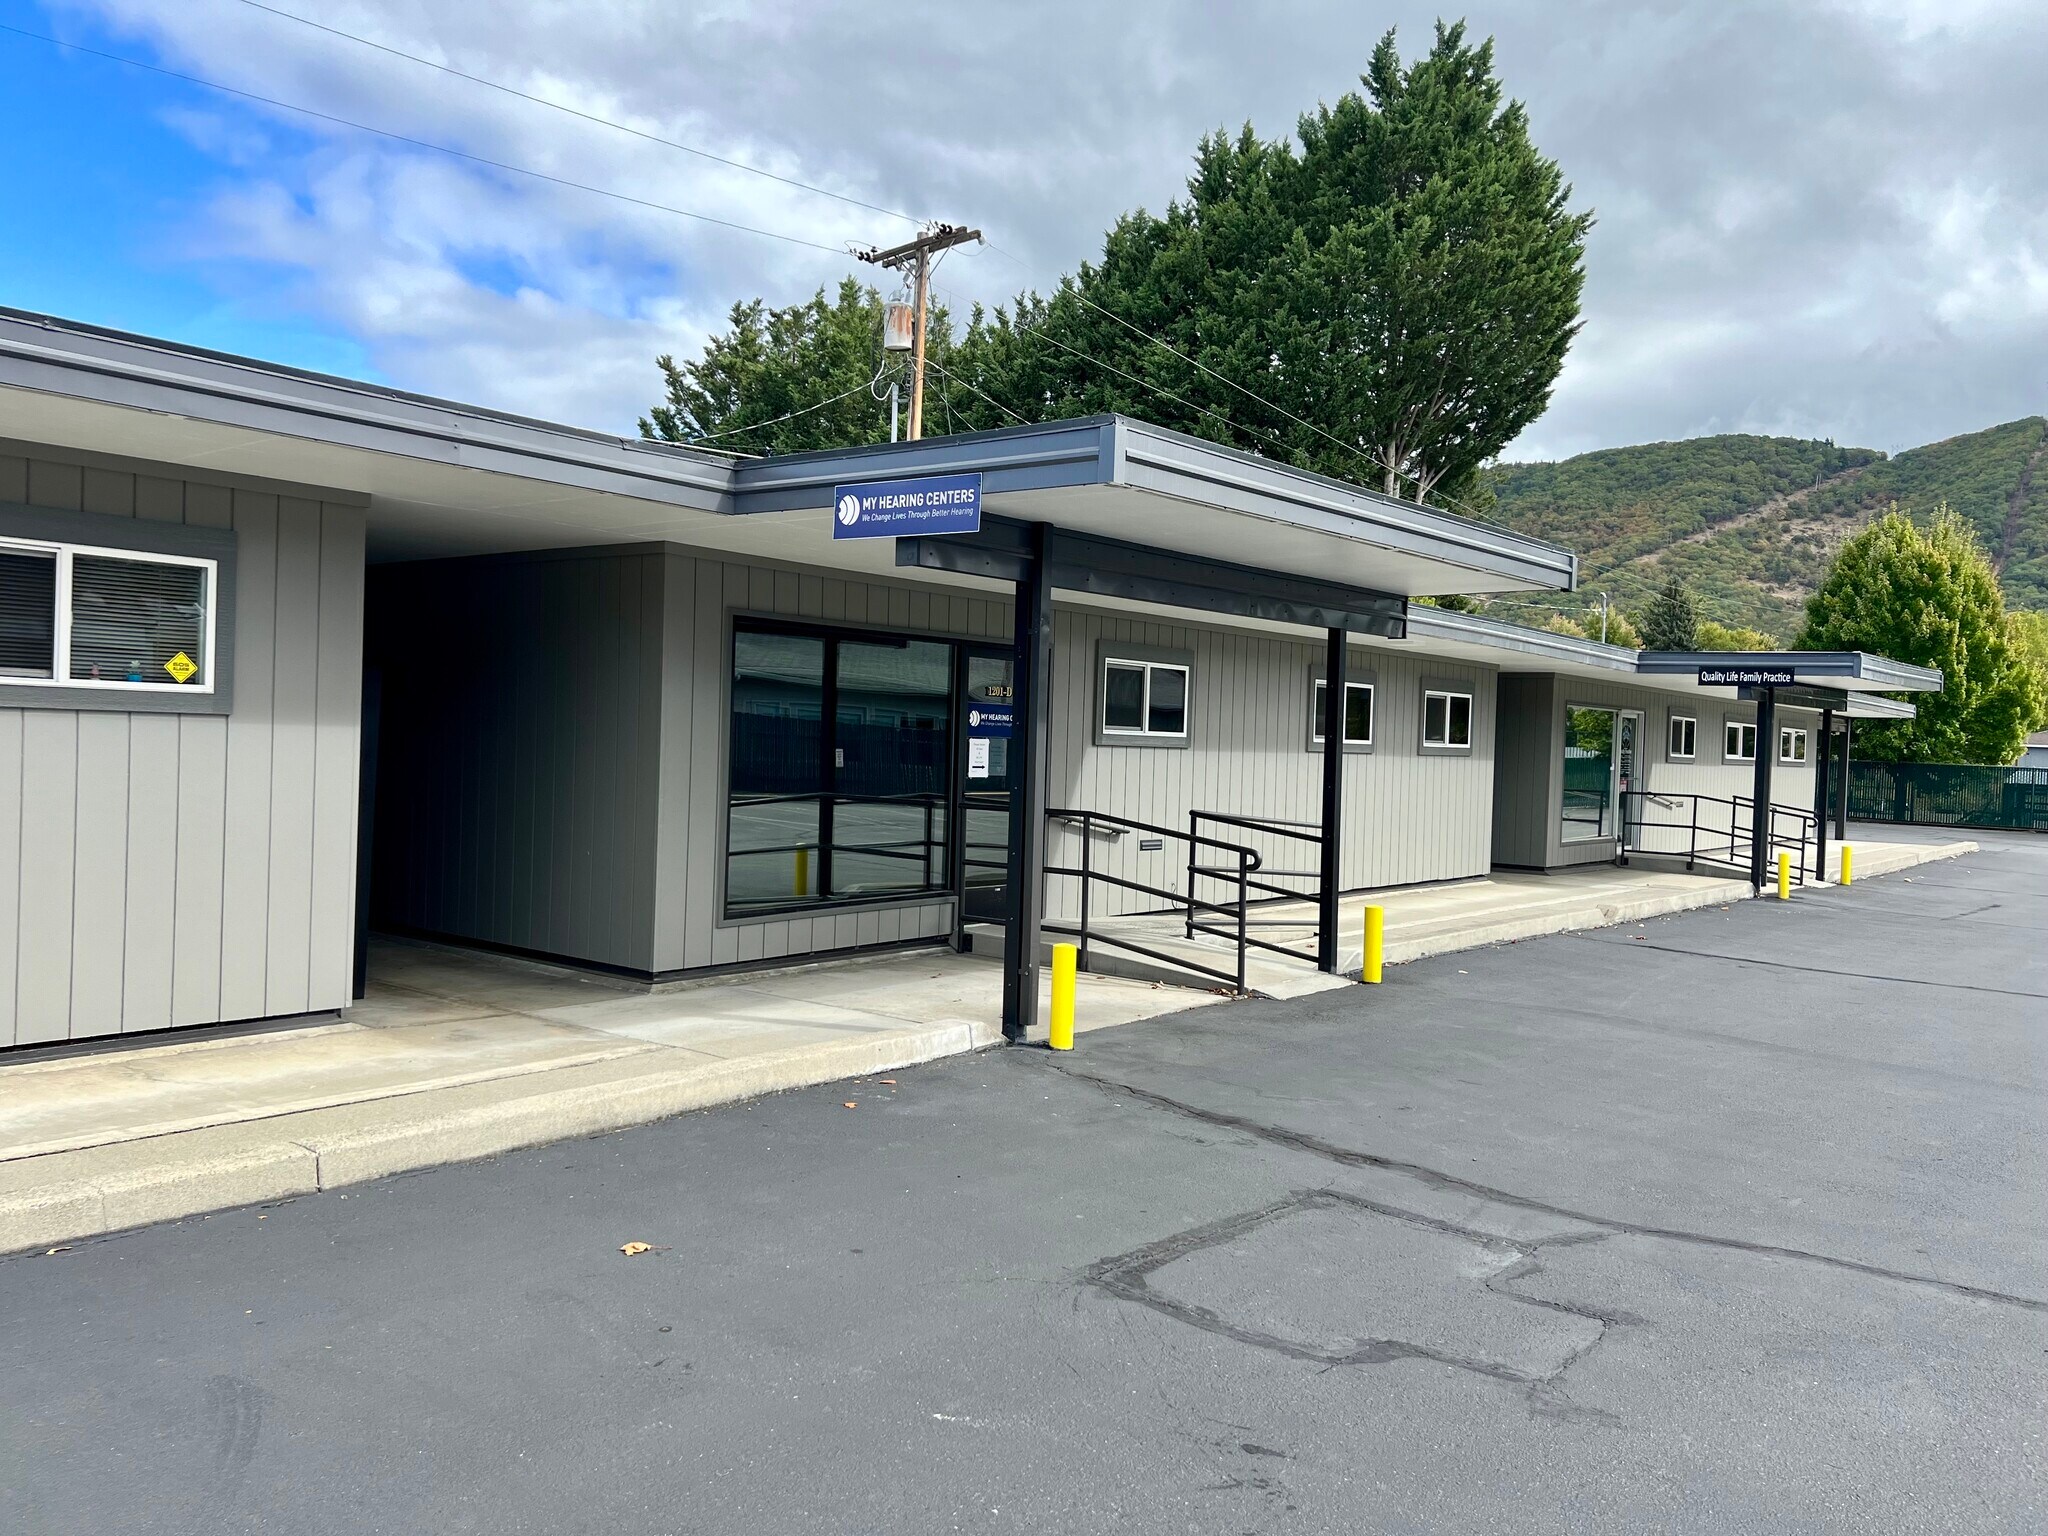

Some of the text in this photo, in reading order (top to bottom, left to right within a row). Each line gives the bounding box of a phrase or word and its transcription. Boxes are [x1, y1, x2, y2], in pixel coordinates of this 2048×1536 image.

[862, 489, 975, 510] MY HEARING CENTERS
[862, 507, 974, 522] We Change Lives Through Better Hearing
[1701, 671, 1791, 684] Quality Life Family Practice
